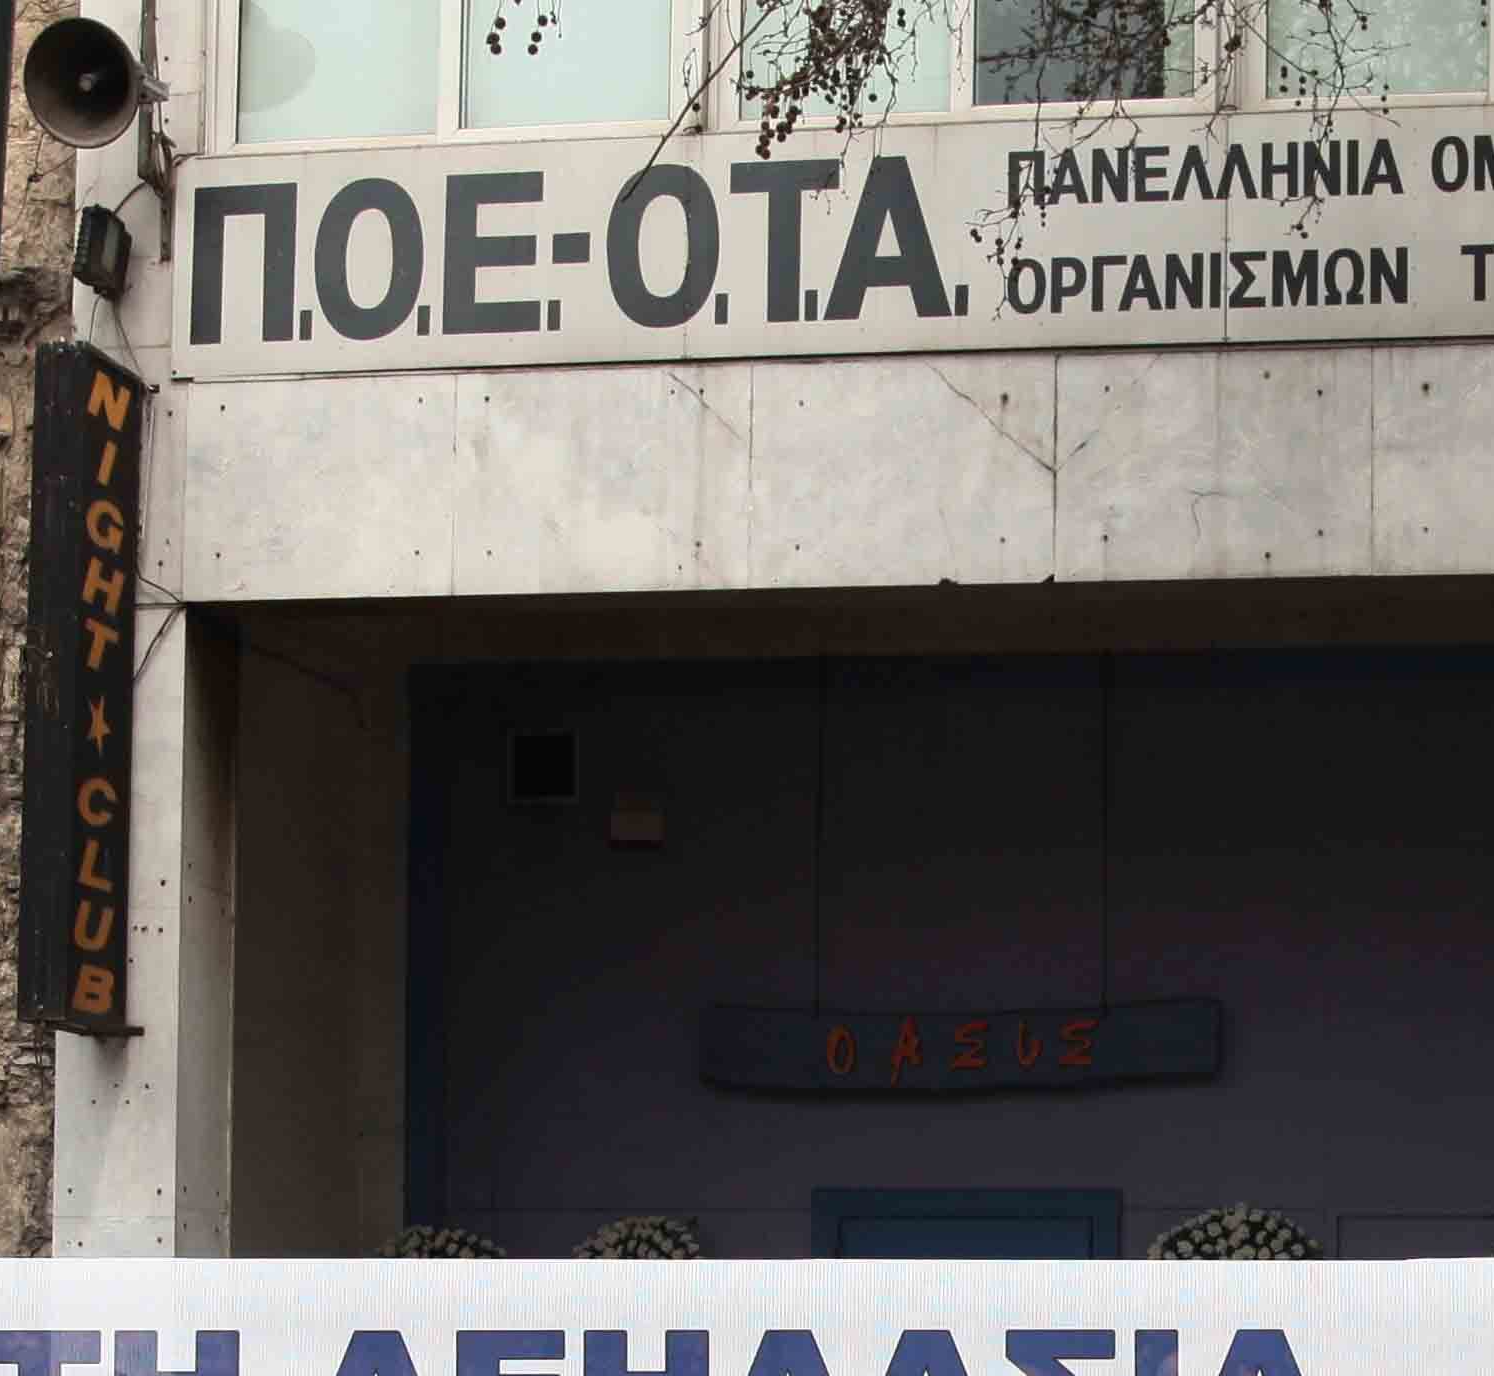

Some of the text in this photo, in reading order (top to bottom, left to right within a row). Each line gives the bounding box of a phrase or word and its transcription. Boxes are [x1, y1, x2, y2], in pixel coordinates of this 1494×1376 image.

[1007, 138, 1404, 208] ΠΑΝΕΛΛΗΝΙΑ
[1007, 246, 1407, 315] ΟΡΓΑΝΙΣΜΩΝ
[73, 370, 131, 1014] NIGHT CLUB
